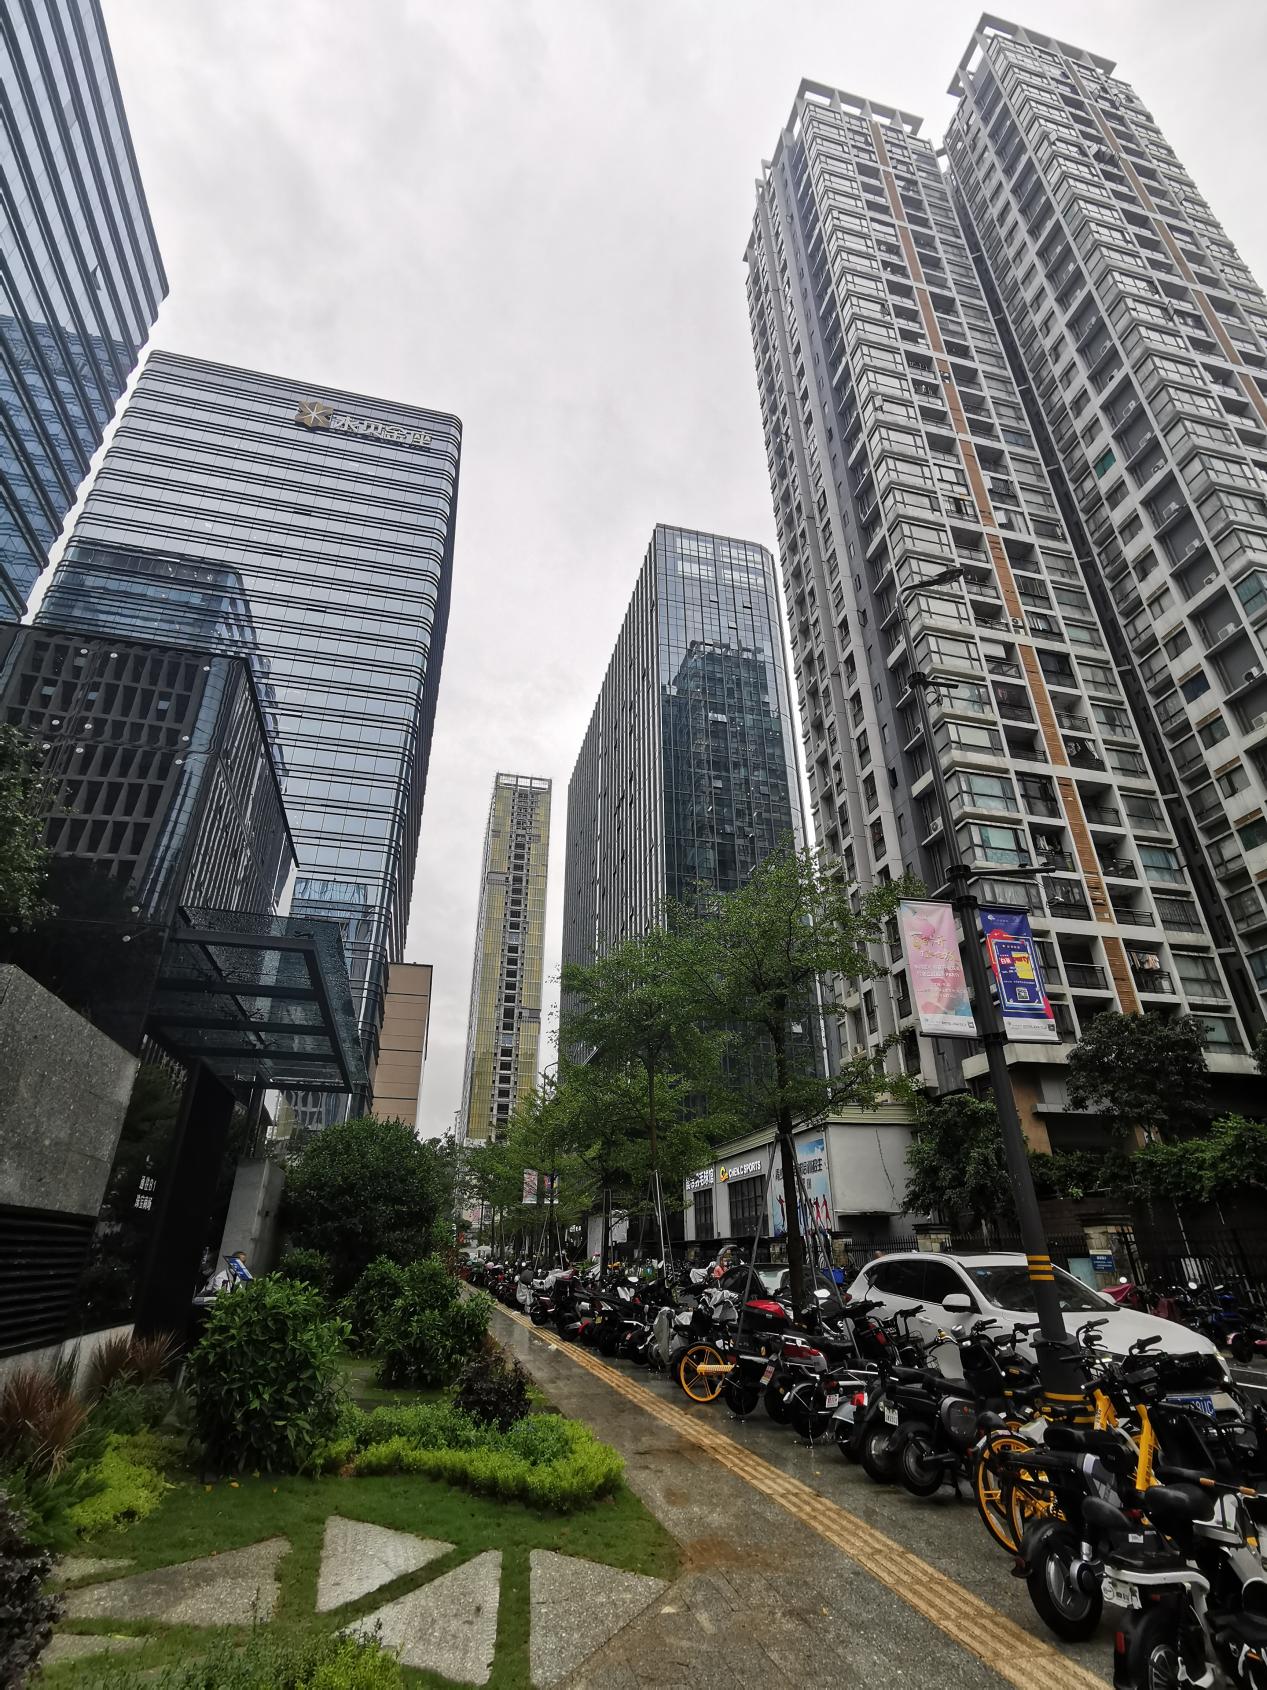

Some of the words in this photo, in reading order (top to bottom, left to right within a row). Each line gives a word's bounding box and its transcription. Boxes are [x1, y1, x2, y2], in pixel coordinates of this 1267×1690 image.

[332, 415, 433, 447] 水贝金座
[743, 1160, 761, 1174] SPORTS
